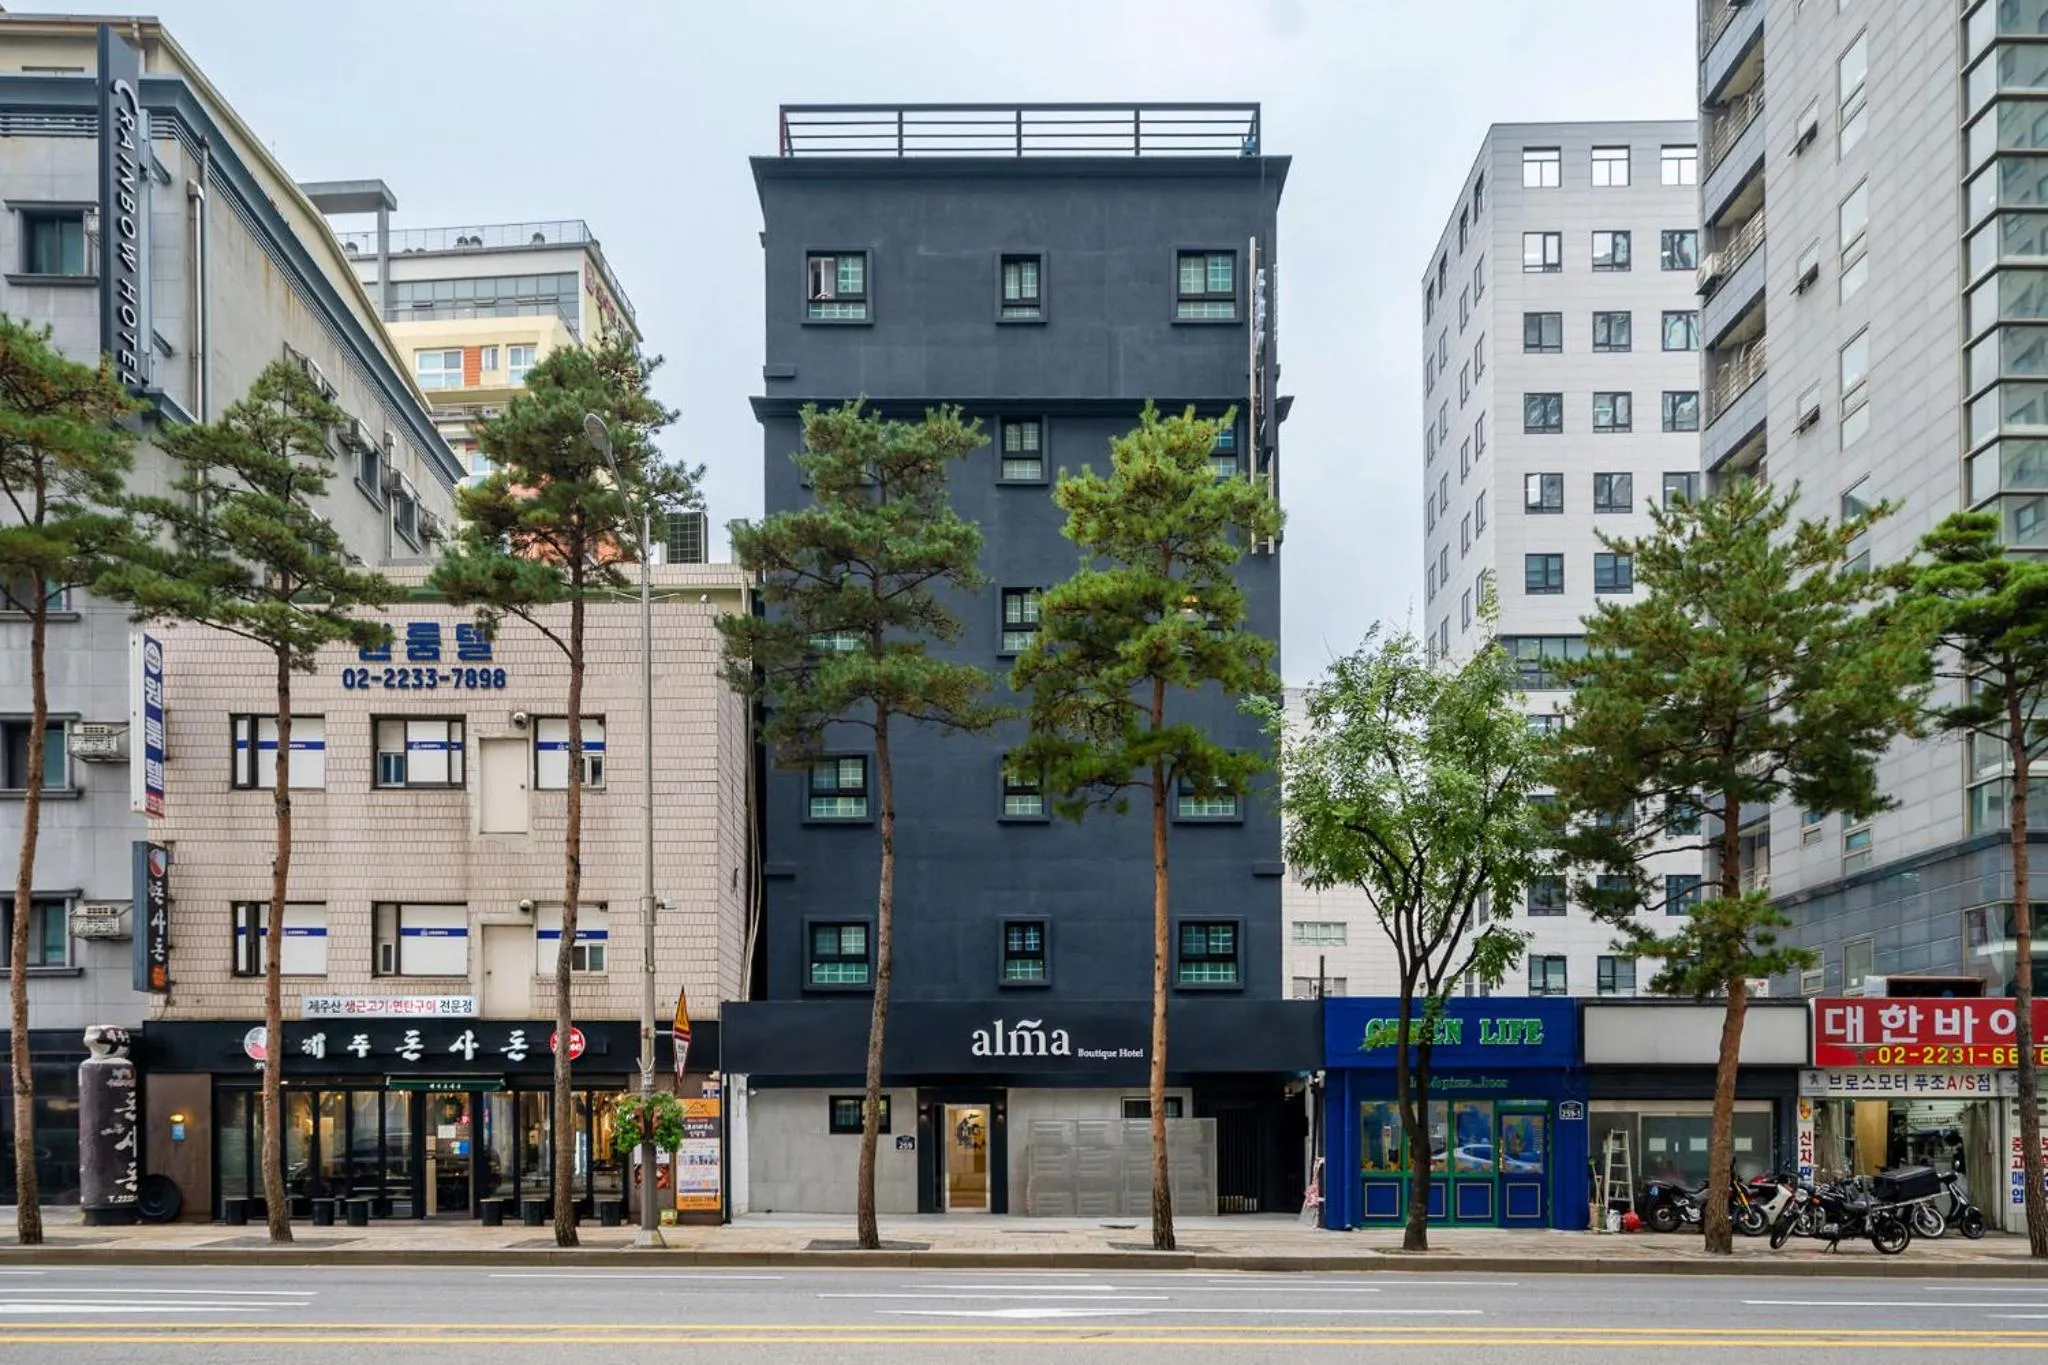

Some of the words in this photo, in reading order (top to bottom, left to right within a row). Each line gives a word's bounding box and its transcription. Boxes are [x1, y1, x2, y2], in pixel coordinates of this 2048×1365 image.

[118, 106, 136, 273] RAINBOW
[119, 277, 138, 386] HOTEL
[342, 667, 507, 690] 02-2233-7898
[307, 999, 342, 1015] 제주산
[439, 999, 473, 1015] 전문점
[1478, 1017, 1545, 1046] LIFE
[1077, 1047, 1117, 1060] Boutique
[1118, 1047, 1144, 1058] Hotel
[1877, 1046, 2048, 1065] 02-2231-666
[1827, 1072, 1909, 1092] 브로스모터
